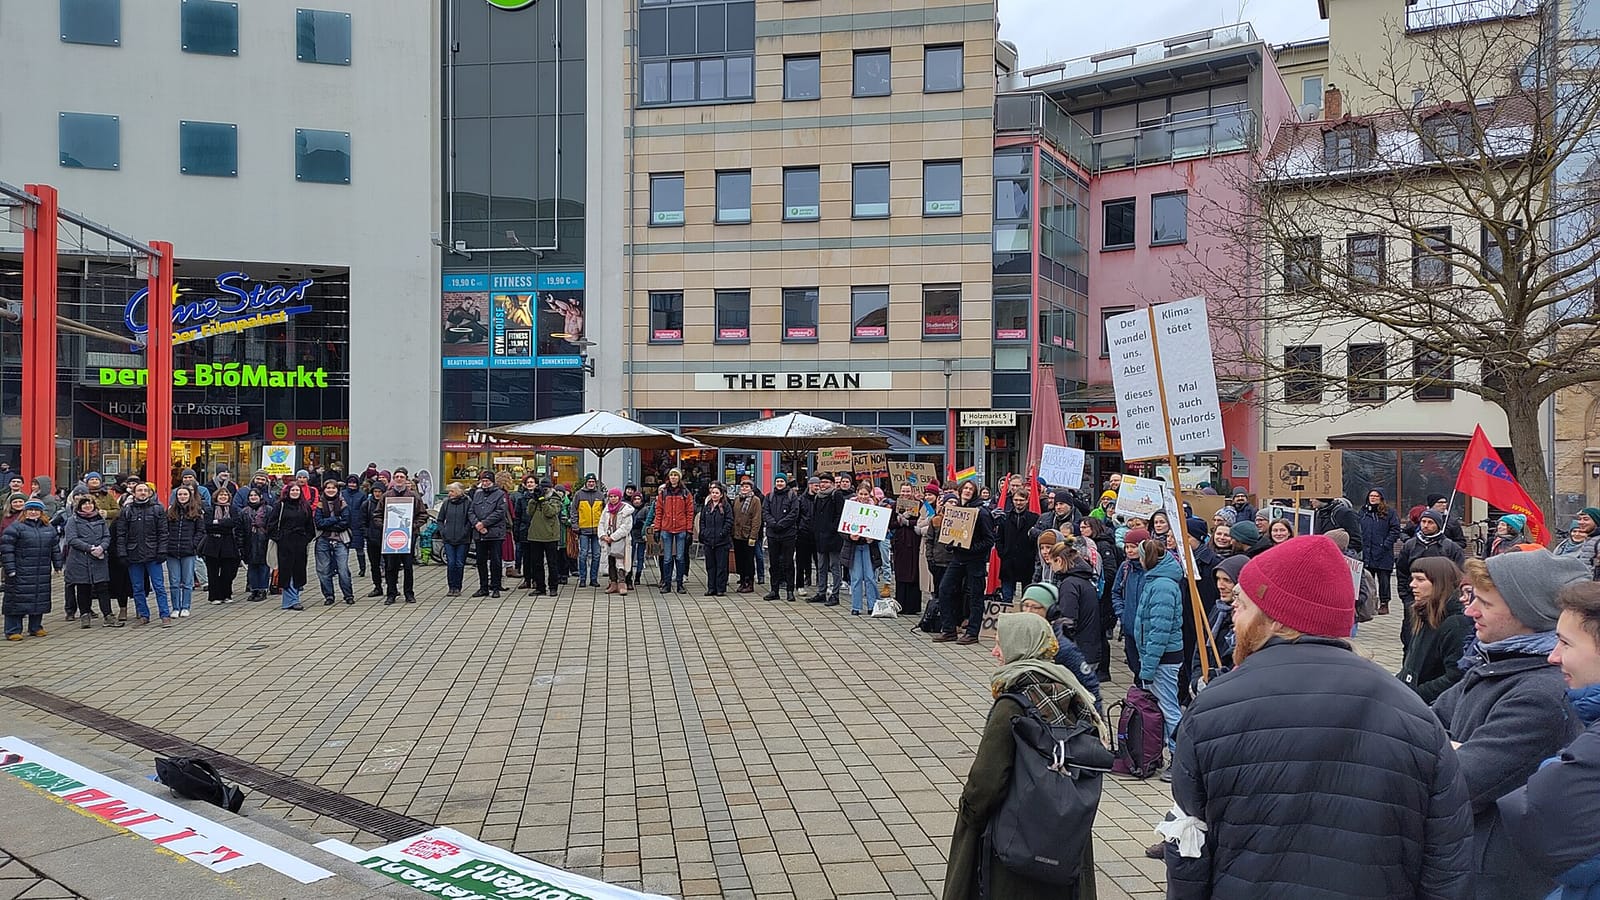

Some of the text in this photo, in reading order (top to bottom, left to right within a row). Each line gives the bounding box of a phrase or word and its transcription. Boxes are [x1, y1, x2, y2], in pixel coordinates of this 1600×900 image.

[494, 276, 532, 288] FITNESS
[124, 271, 314, 334] CneStar
[201, 310, 287, 335] Filmpalast
[1120, 307, 1193, 329] Der Klima-
[1114, 322, 1192, 346] wandel tötet
[1122, 350, 1142, 360] uns.
[1123, 364, 1145, 376] Aber
[723, 373, 861, 390] THE BEAN
[1124, 381, 1198, 401] dieses Mal
[1126, 397, 1202, 418] gehen auch
[1135, 420, 1150, 430] die
[1170, 411, 1216, 427] Warlords
[1137, 428, 1211, 446] mit unter!
[853, 455, 868, 465] ACT
[943, 518, 954, 527] FOR
[945, 508, 970, 520] STUDENTS
